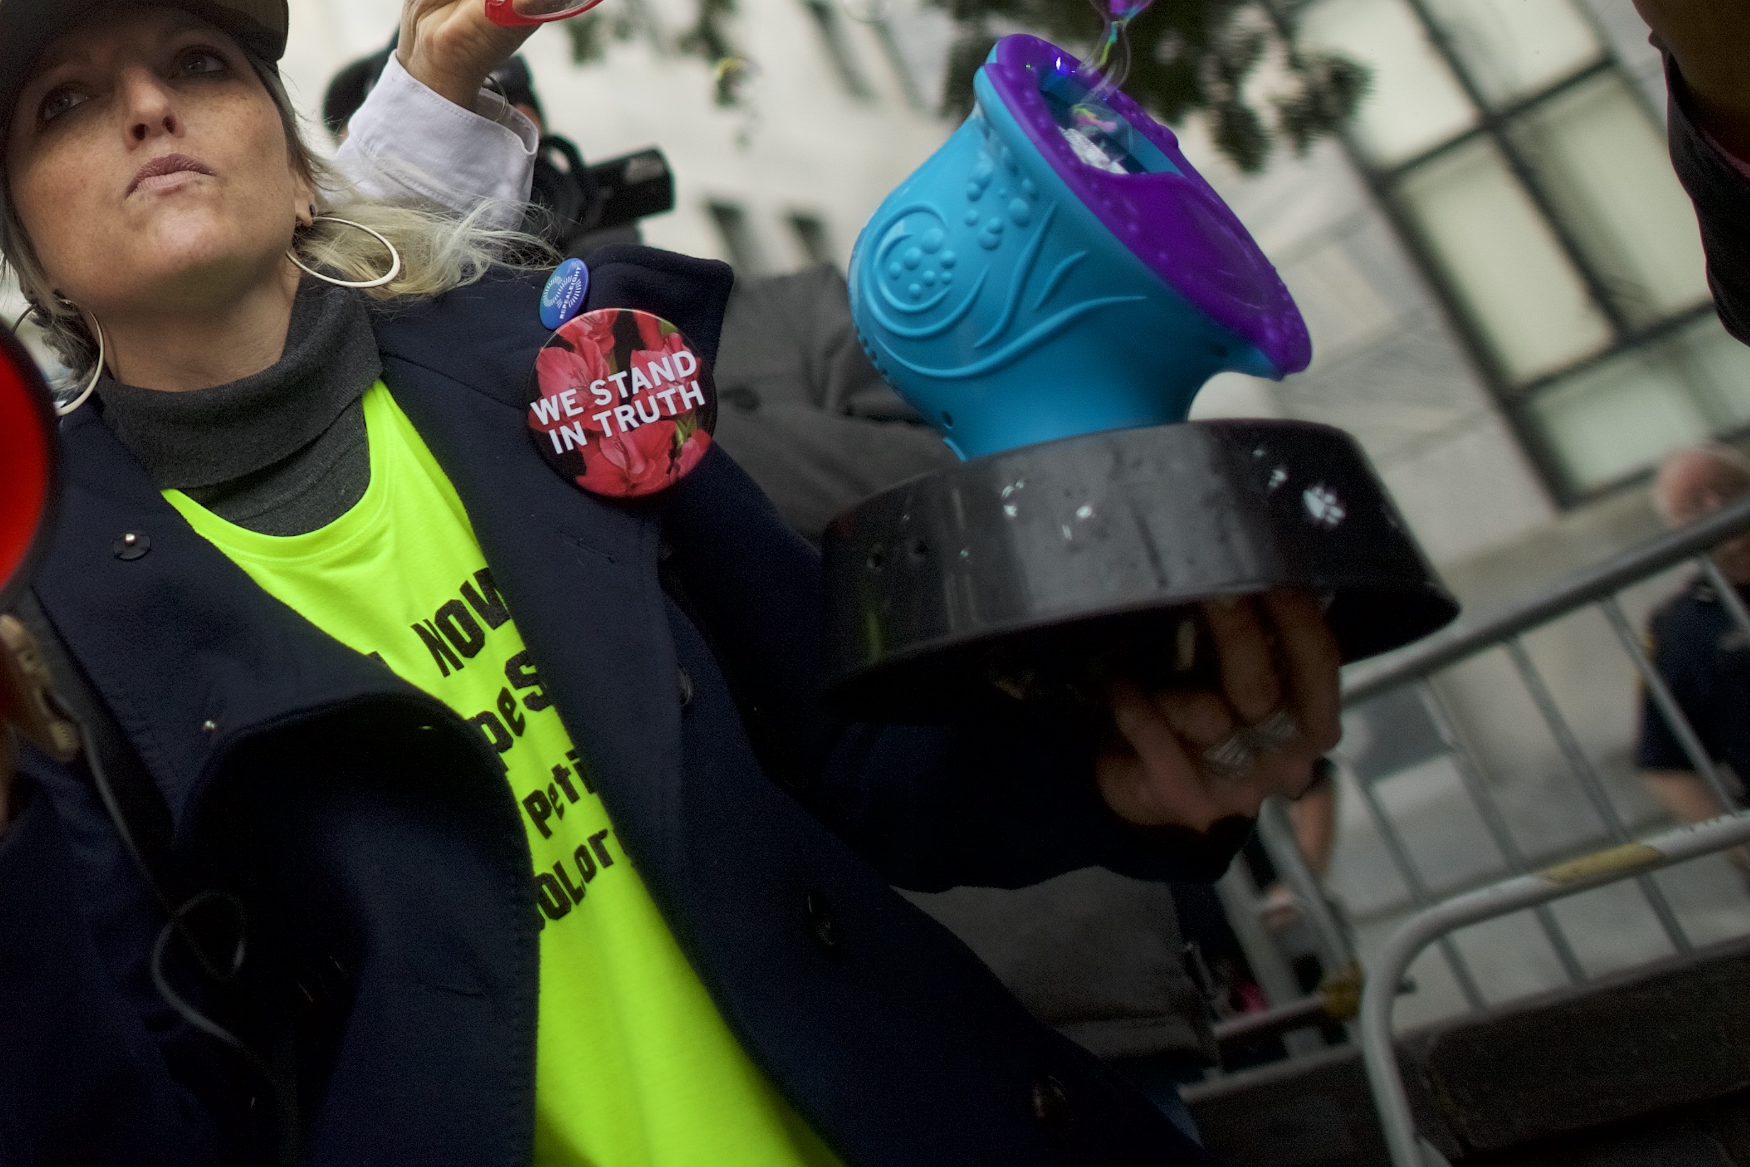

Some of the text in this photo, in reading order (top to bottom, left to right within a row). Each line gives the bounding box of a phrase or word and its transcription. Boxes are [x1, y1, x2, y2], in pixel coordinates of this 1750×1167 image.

[529, 350, 698, 426] WE STAND
[548, 380, 706, 455] IN TRUTH
